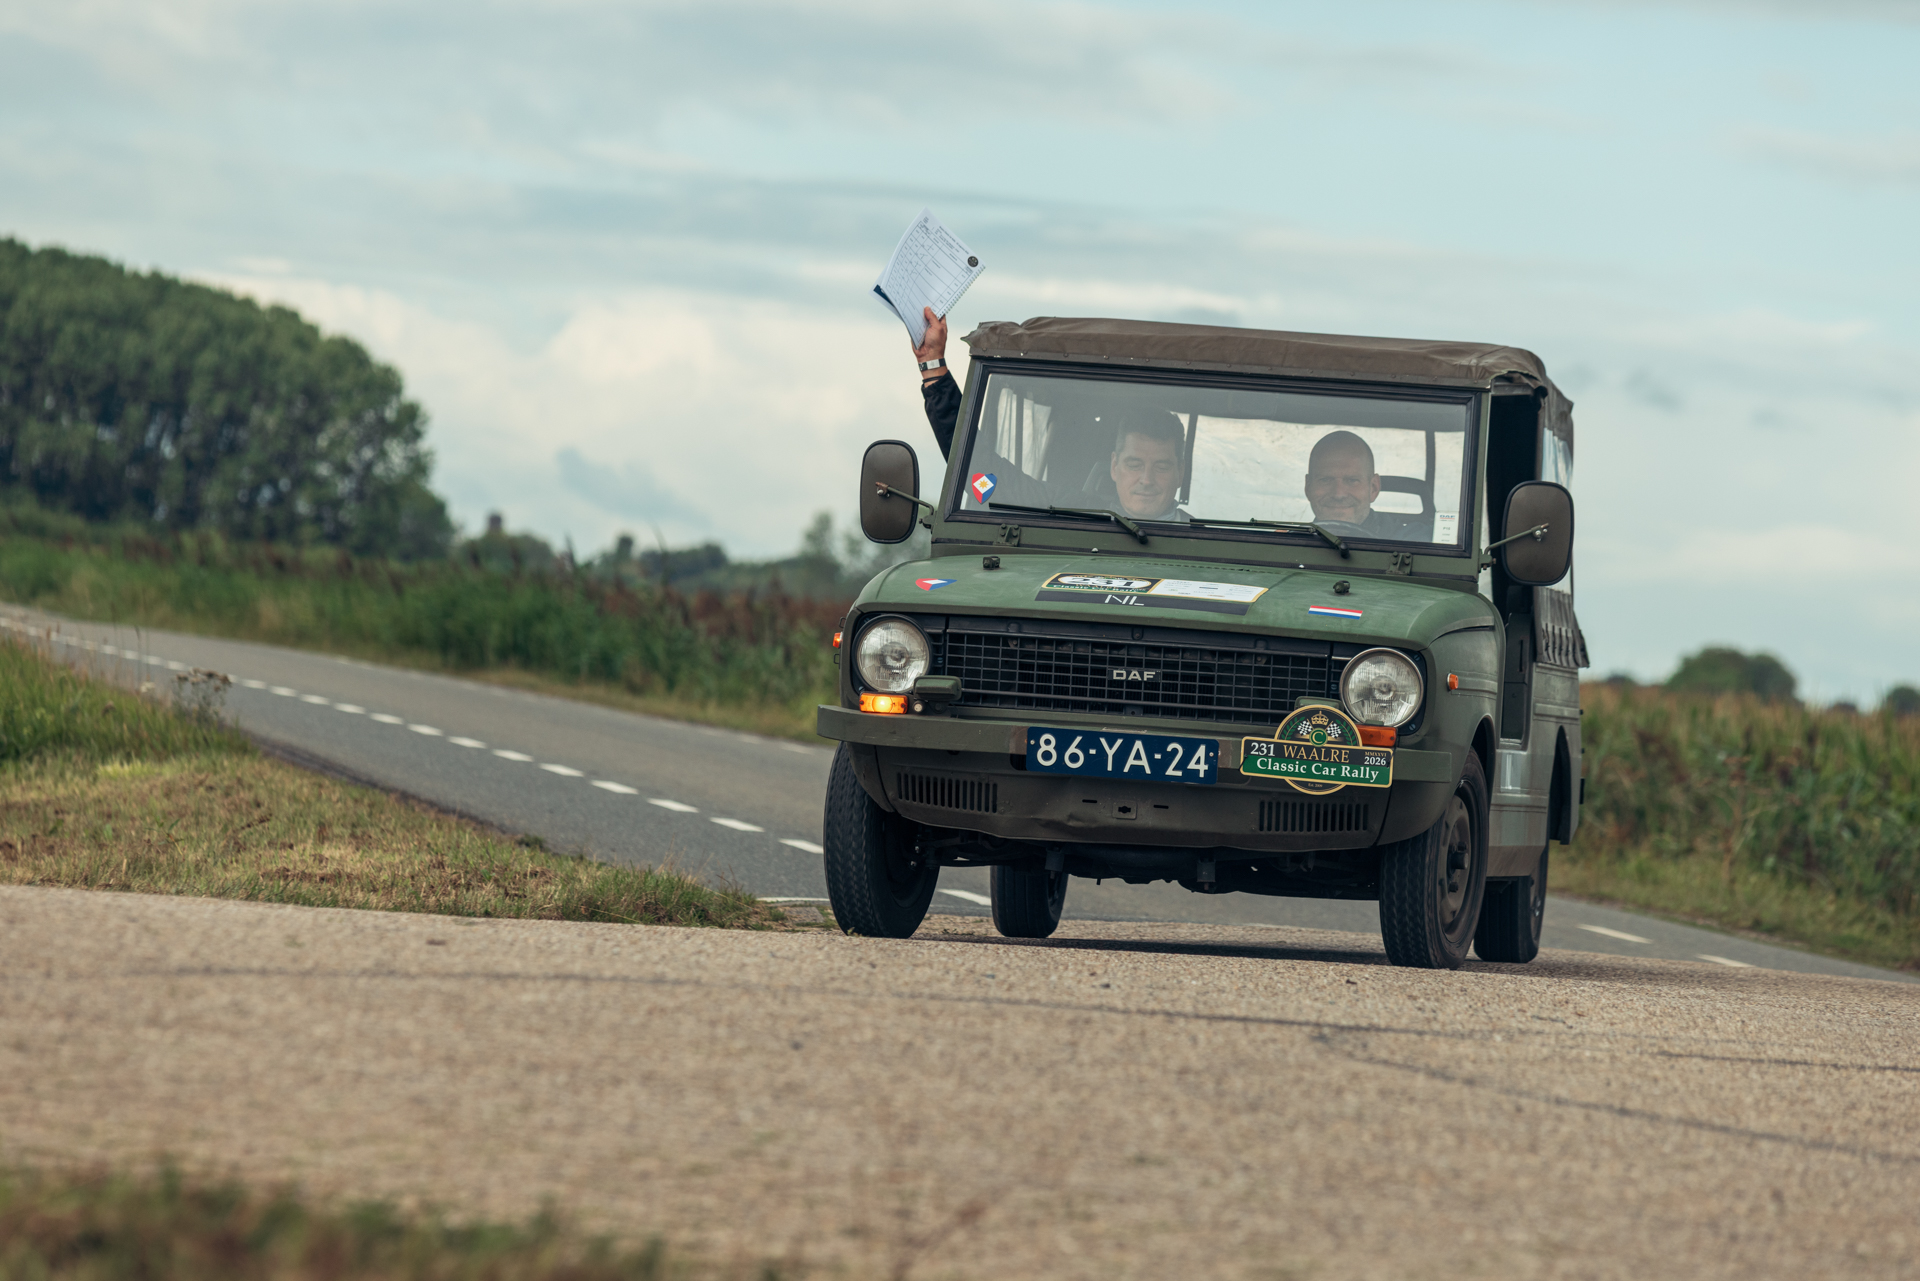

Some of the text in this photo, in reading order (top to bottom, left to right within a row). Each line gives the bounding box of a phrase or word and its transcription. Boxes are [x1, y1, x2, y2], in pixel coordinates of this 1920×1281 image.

[1104, 594, 1145, 606] NL
[1113, 669, 1156, 681] DAF
[1312, 731, 1324, 744] C
[1036, 733, 1209, 778] 86-YA-24
[1250, 742, 1350, 763] 231 WAALRE
[1364, 756, 1387, 766] 2026
[1256, 757, 1379, 782] Classic Car Rally
